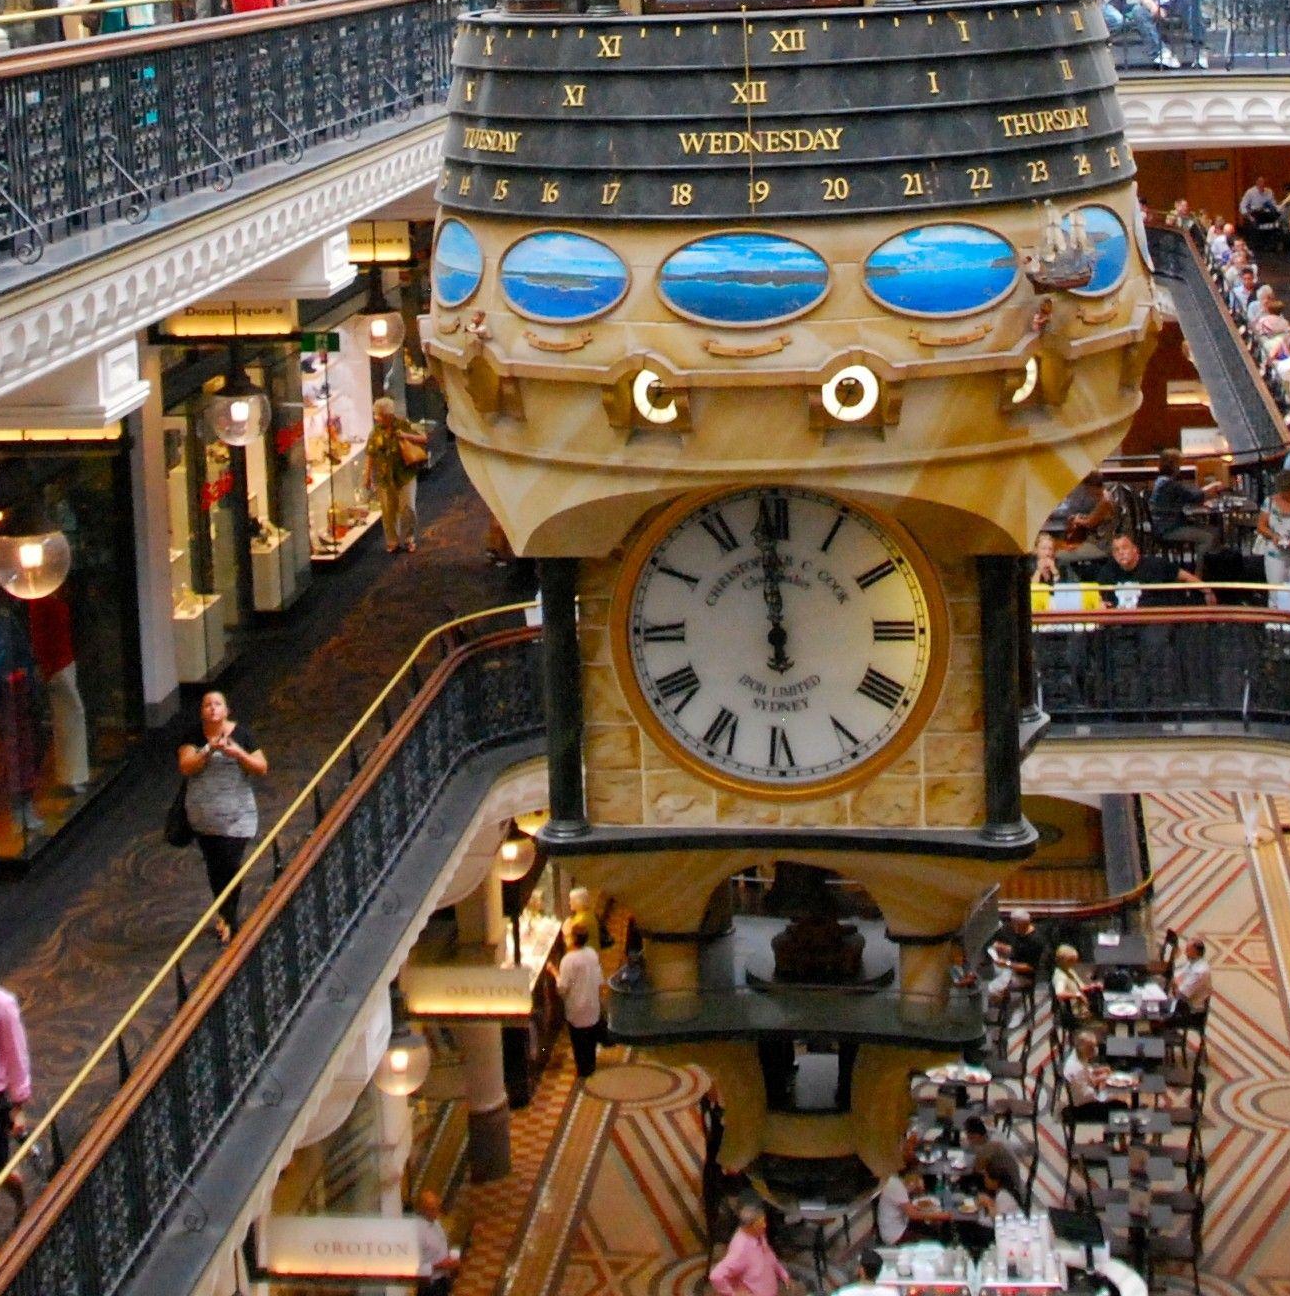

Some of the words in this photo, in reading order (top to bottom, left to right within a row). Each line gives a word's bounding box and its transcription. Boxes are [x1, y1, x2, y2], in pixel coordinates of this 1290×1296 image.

[597, 35, 623, 58] XI
[770, 29, 807, 53] XII
[958, 20, 970, 42] I
[1070, 10, 1084, 32] II
[563, 85, 587, 107] XI
[731, 81, 768, 104] XII
[927, 71, 940, 94] I
[1059, 59, 1074, 81] II
[464, 128, 522, 153] TUESDAY
[679, 127, 844, 154] WEDNESDAY
[998, 106, 1089, 137] THURSDAY
[493, 179, 508, 201] 15
[541, 181, 559, 204] 16
[601, 182, 621, 205] 17
[670, 183, 693, 206] 18
[748, 180, 770, 204] 19
[821, 177, 849, 201] 20
[901, 173, 924, 196] 21
[966, 167, 993, 190] 22
[1027, 160, 1049, 183] 23
[1073, 154, 1092, 176] 24
[873, 619, 916, 643] III
[314, 1242, 409, 1256] OROTON
